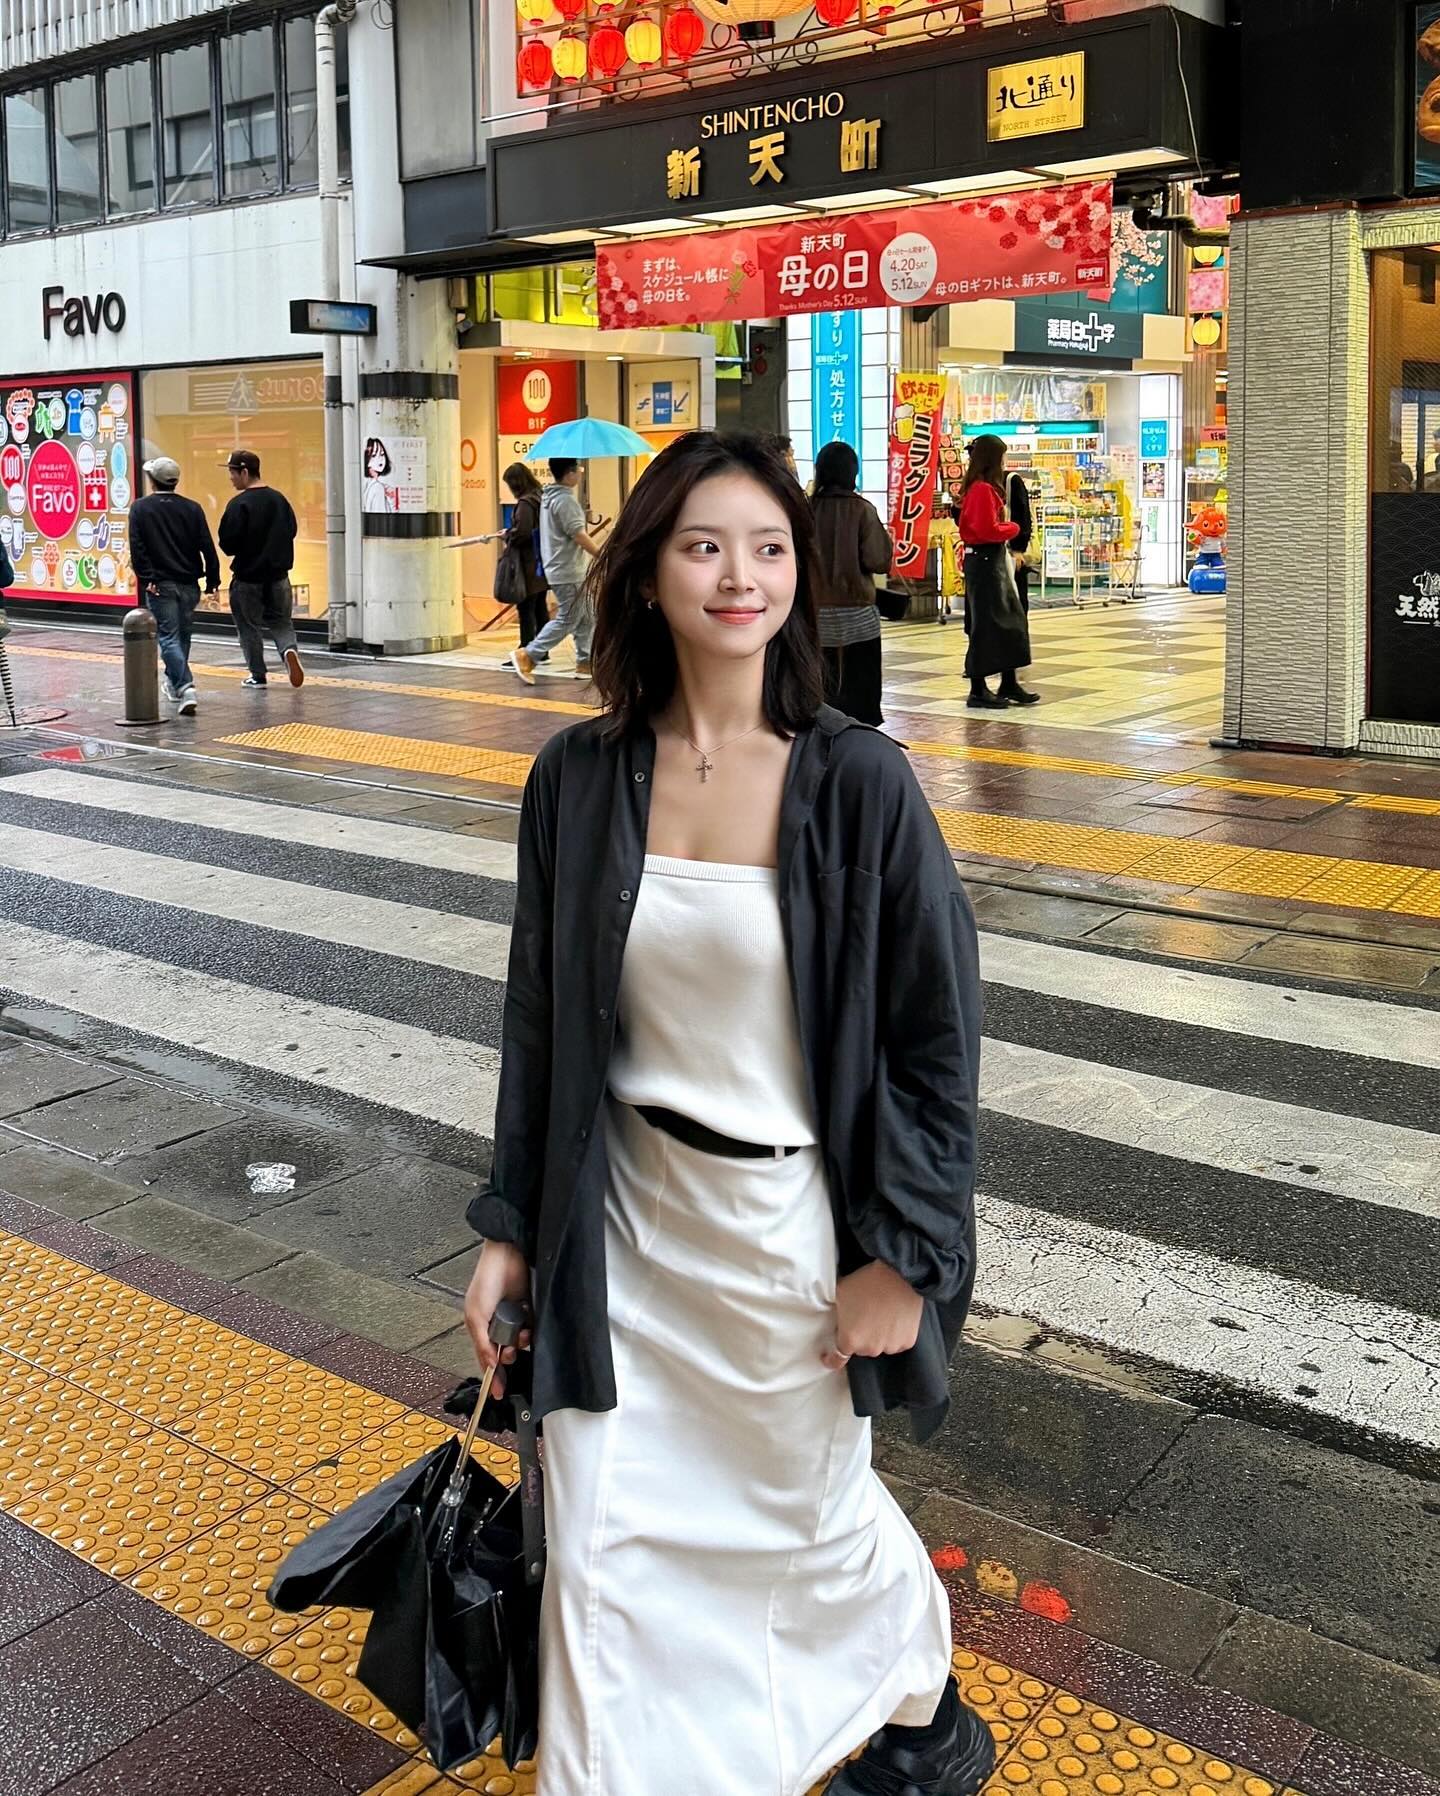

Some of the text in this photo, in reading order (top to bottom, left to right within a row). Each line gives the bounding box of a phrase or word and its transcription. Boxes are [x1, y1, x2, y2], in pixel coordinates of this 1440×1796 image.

[996, 75, 1074, 112] 北通り
[701, 92, 844, 139] SHINTENCHO
[1003, 114, 1068, 132] NORTH STREET
[666, 118, 882, 200] 新天町
[801, 232, 847, 254] 新天町
[642, 267, 729, 289] スケジュール帳に
[777, 249, 869, 298] 母の日
[42, 285, 126, 340] Favo
[528, 378, 546, 398] 100
[32, 484, 77, 514] Favo
[896, 414, 933, 567] ミラグレーン
